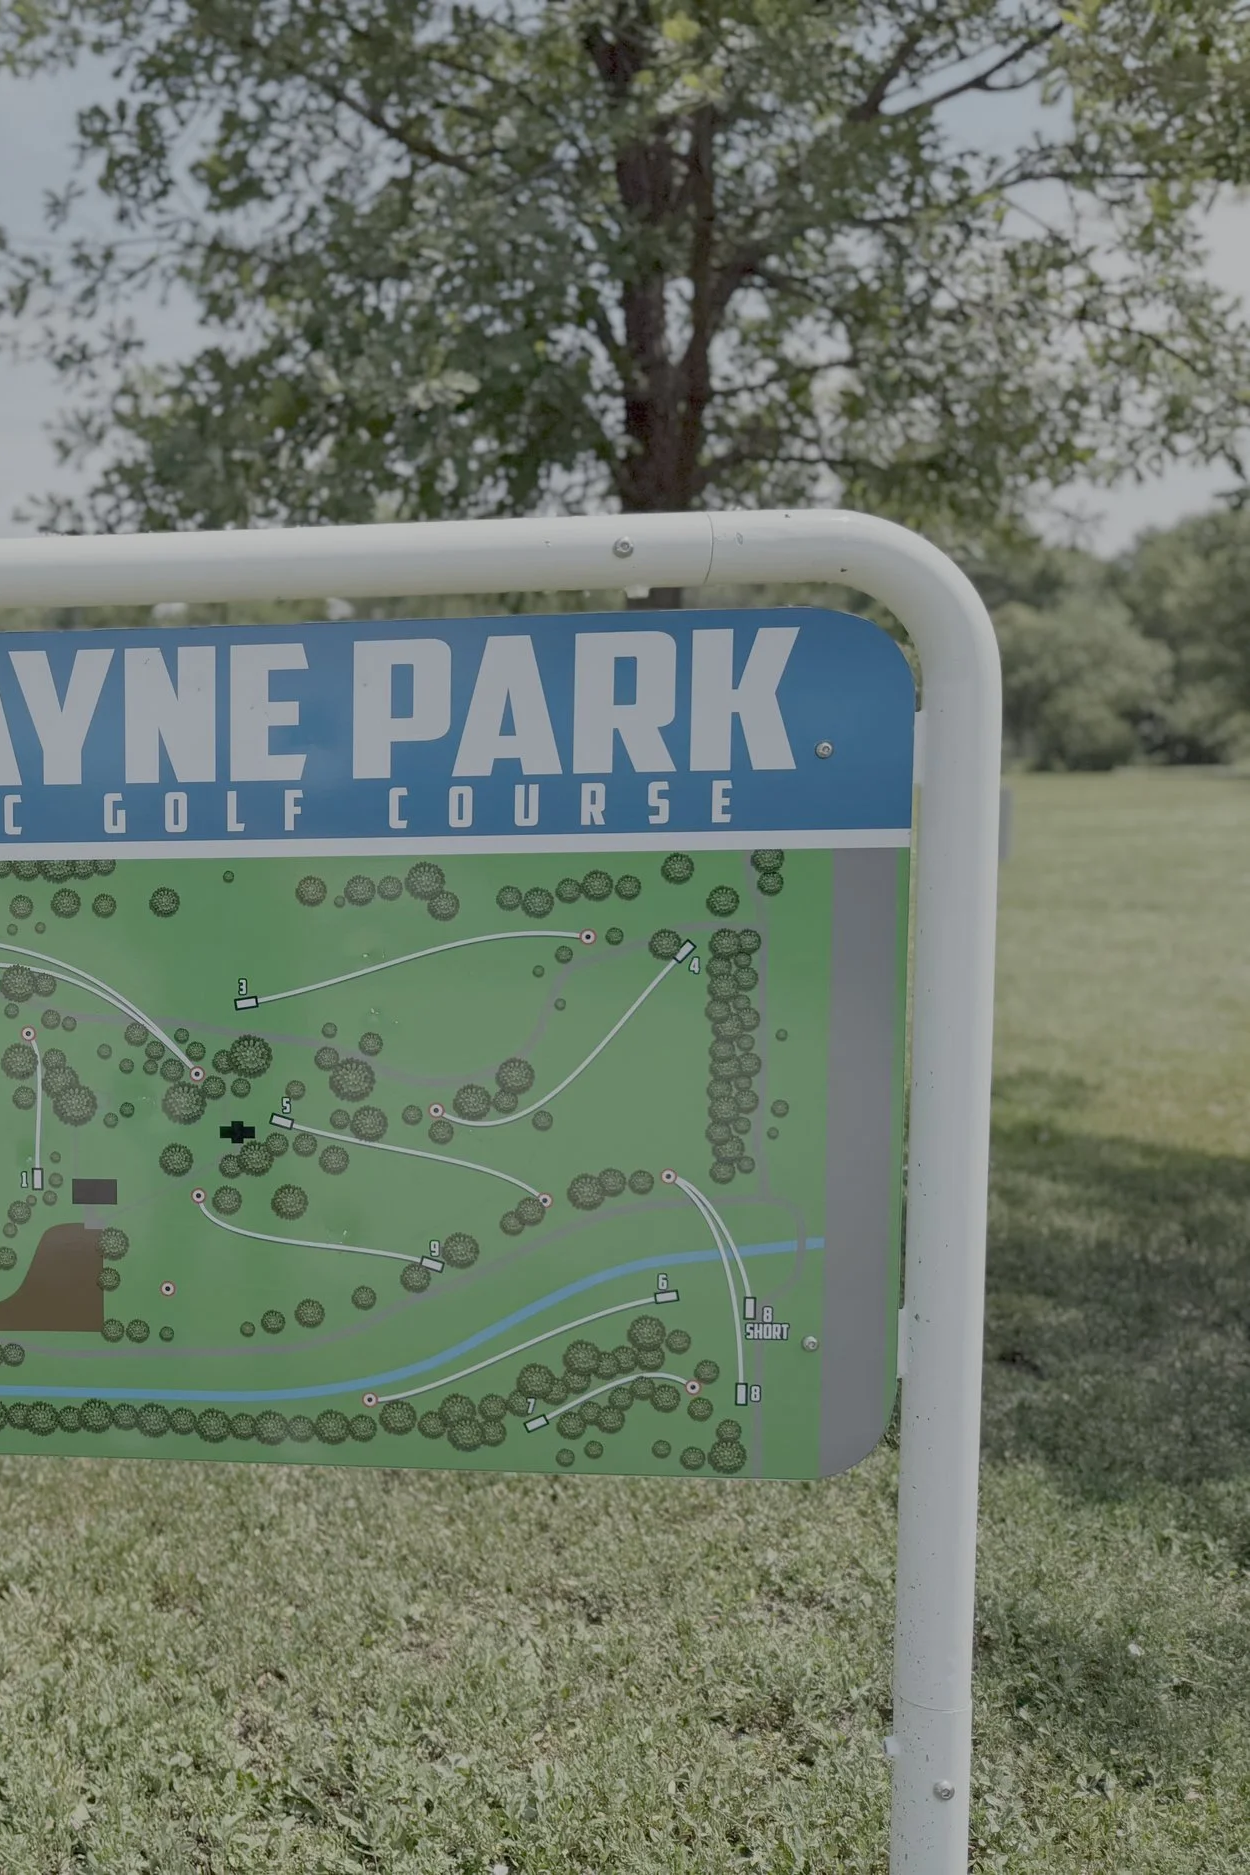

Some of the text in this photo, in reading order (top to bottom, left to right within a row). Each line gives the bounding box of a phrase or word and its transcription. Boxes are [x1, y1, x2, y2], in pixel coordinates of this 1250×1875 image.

[352, 626, 801, 779] PARK
[103, 789, 304, 834] GOLF
[388, 779, 733, 829] COURSE
[688, 957, 701, 974] 4
[237, 978, 248, 996] 3
[281, 1097, 292, 1113] 5
[20, 1171, 29, 1189] 1
[429, 1240, 440, 1257] 9
[657, 1273, 668, 1290] 6
[762, 1306, 773, 1322] 8
[745, 1322, 790, 1341] SHORT
[750, 1384, 761, 1402] 8
[525, 1397, 536, 1414] 7
